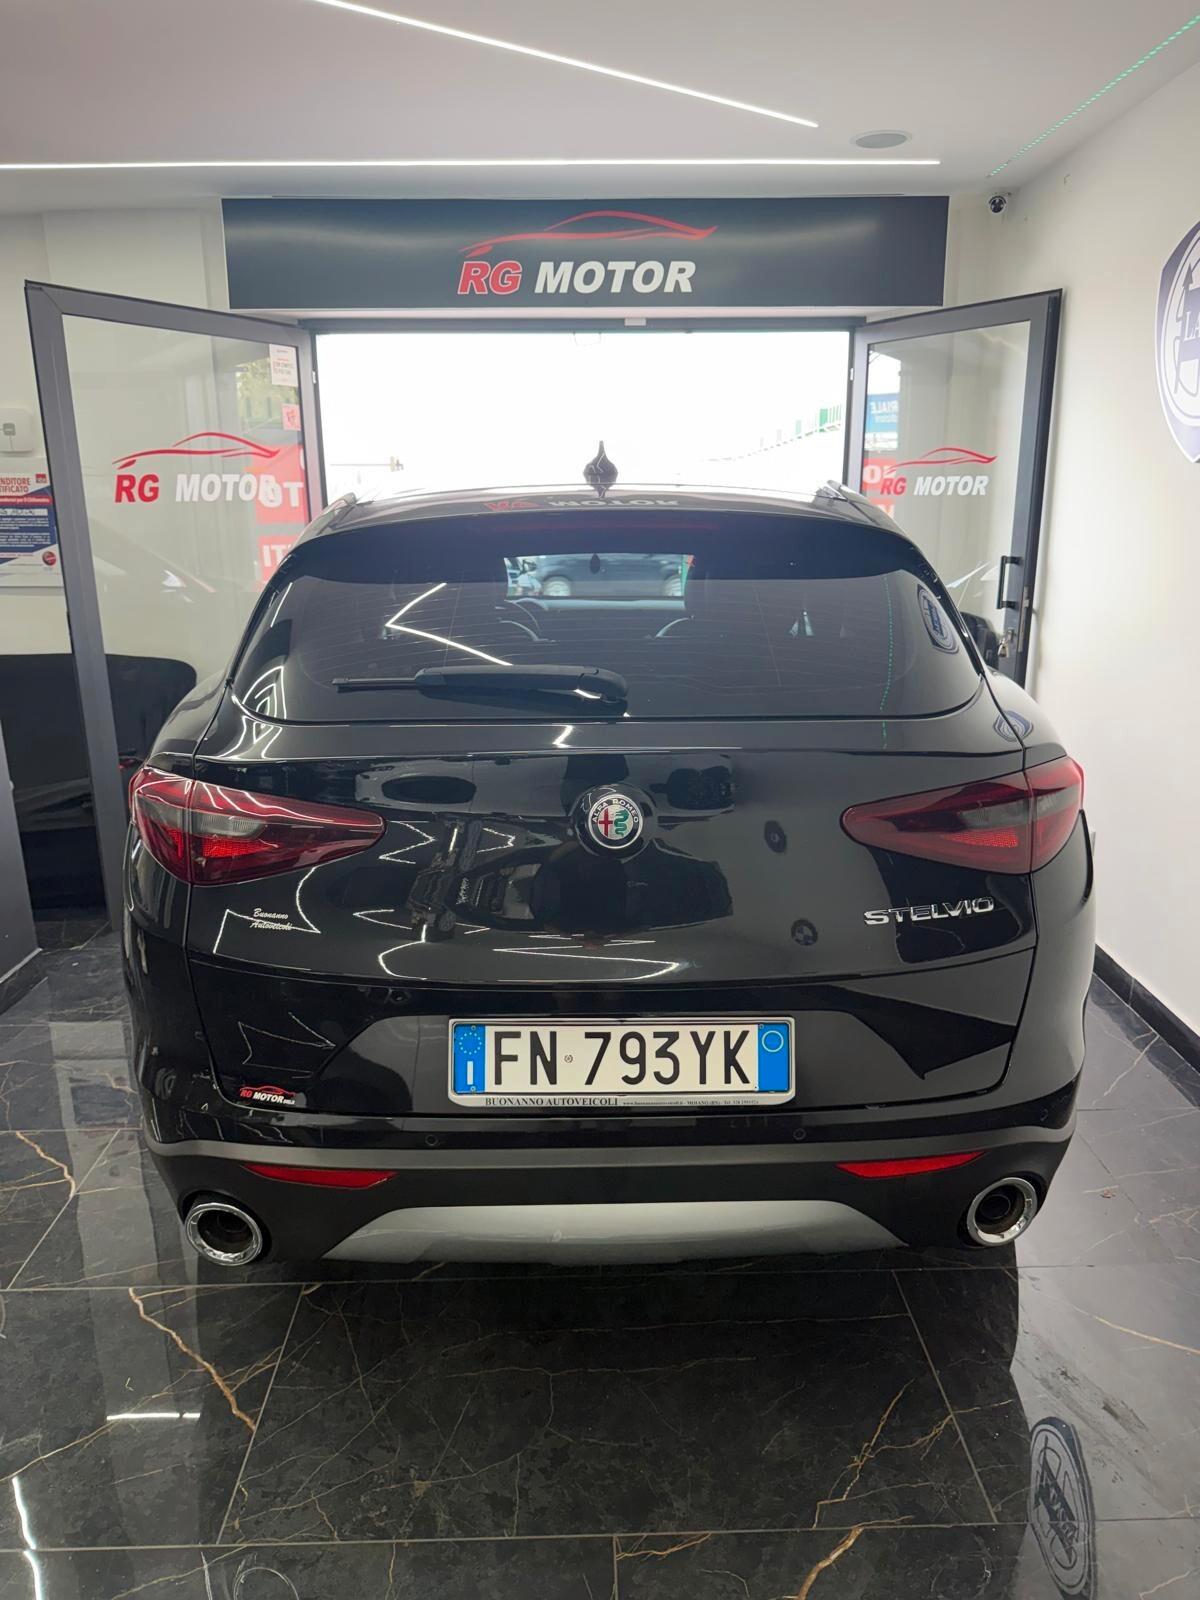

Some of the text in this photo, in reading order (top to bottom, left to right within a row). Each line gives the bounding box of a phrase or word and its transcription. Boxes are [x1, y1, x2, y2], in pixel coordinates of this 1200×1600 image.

[457, 260, 696, 295] RG MOTOR
[114, 473, 274, 503] RG MOTOR
[880, 475, 989, 496] RG MOTOR
[592, 798, 639, 823] ALFA ROMEO
[253, 908, 289, 920] Buonanno
[864, 896, 995, 925] STELVIO
[494, 1030, 751, 1086] FN 793YK
[253, 1091, 285, 1104] MOTOR
[485, 1097, 544, 1106] BUONANNO
[547, 1096, 618, 1106] AUTOVEICOLI
